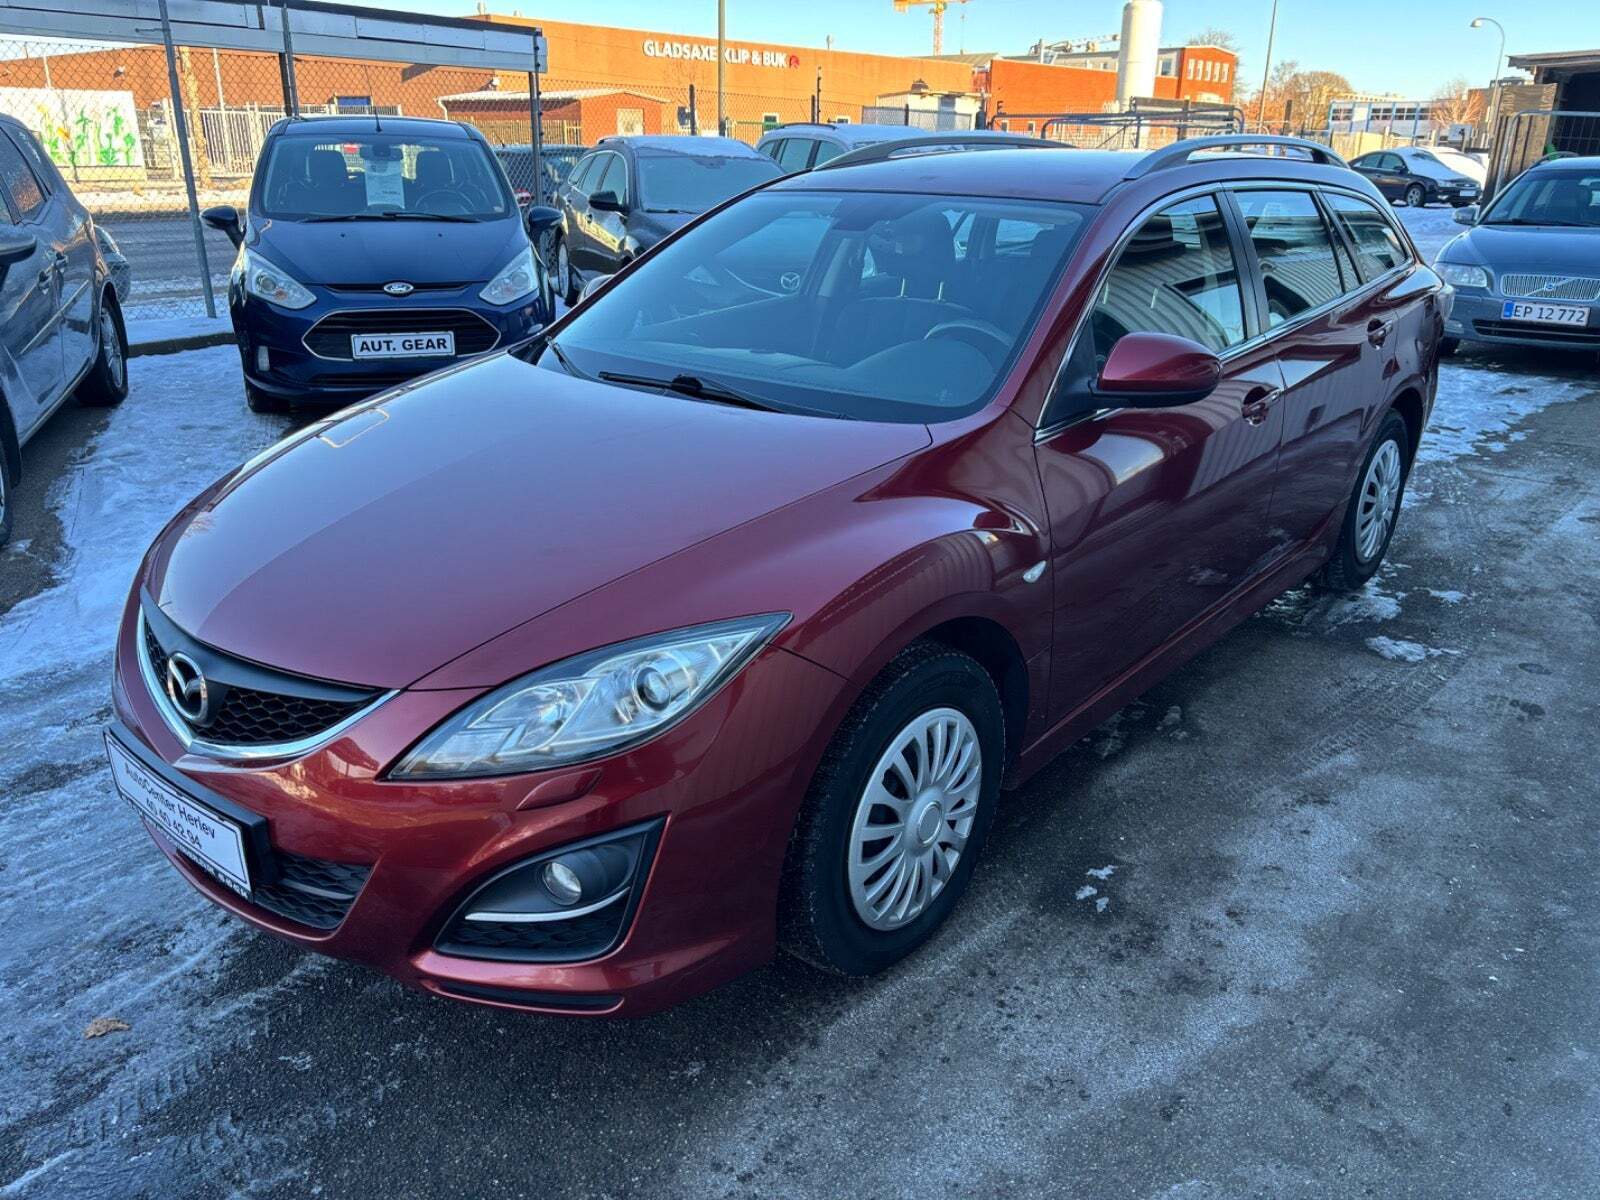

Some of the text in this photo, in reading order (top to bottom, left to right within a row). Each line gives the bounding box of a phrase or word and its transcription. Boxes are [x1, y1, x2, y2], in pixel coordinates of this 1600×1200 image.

[643, 40, 717, 62] GLADSAXE
[751, 50, 762, 65] &
[763, 51, 787, 67] BUK
[1514, 305, 1586, 323] EP 12 772
[360, 338, 447, 352] AUT. GEAR
[173, 820, 188, 839] 42
[177, 803, 216, 839] Herlev
